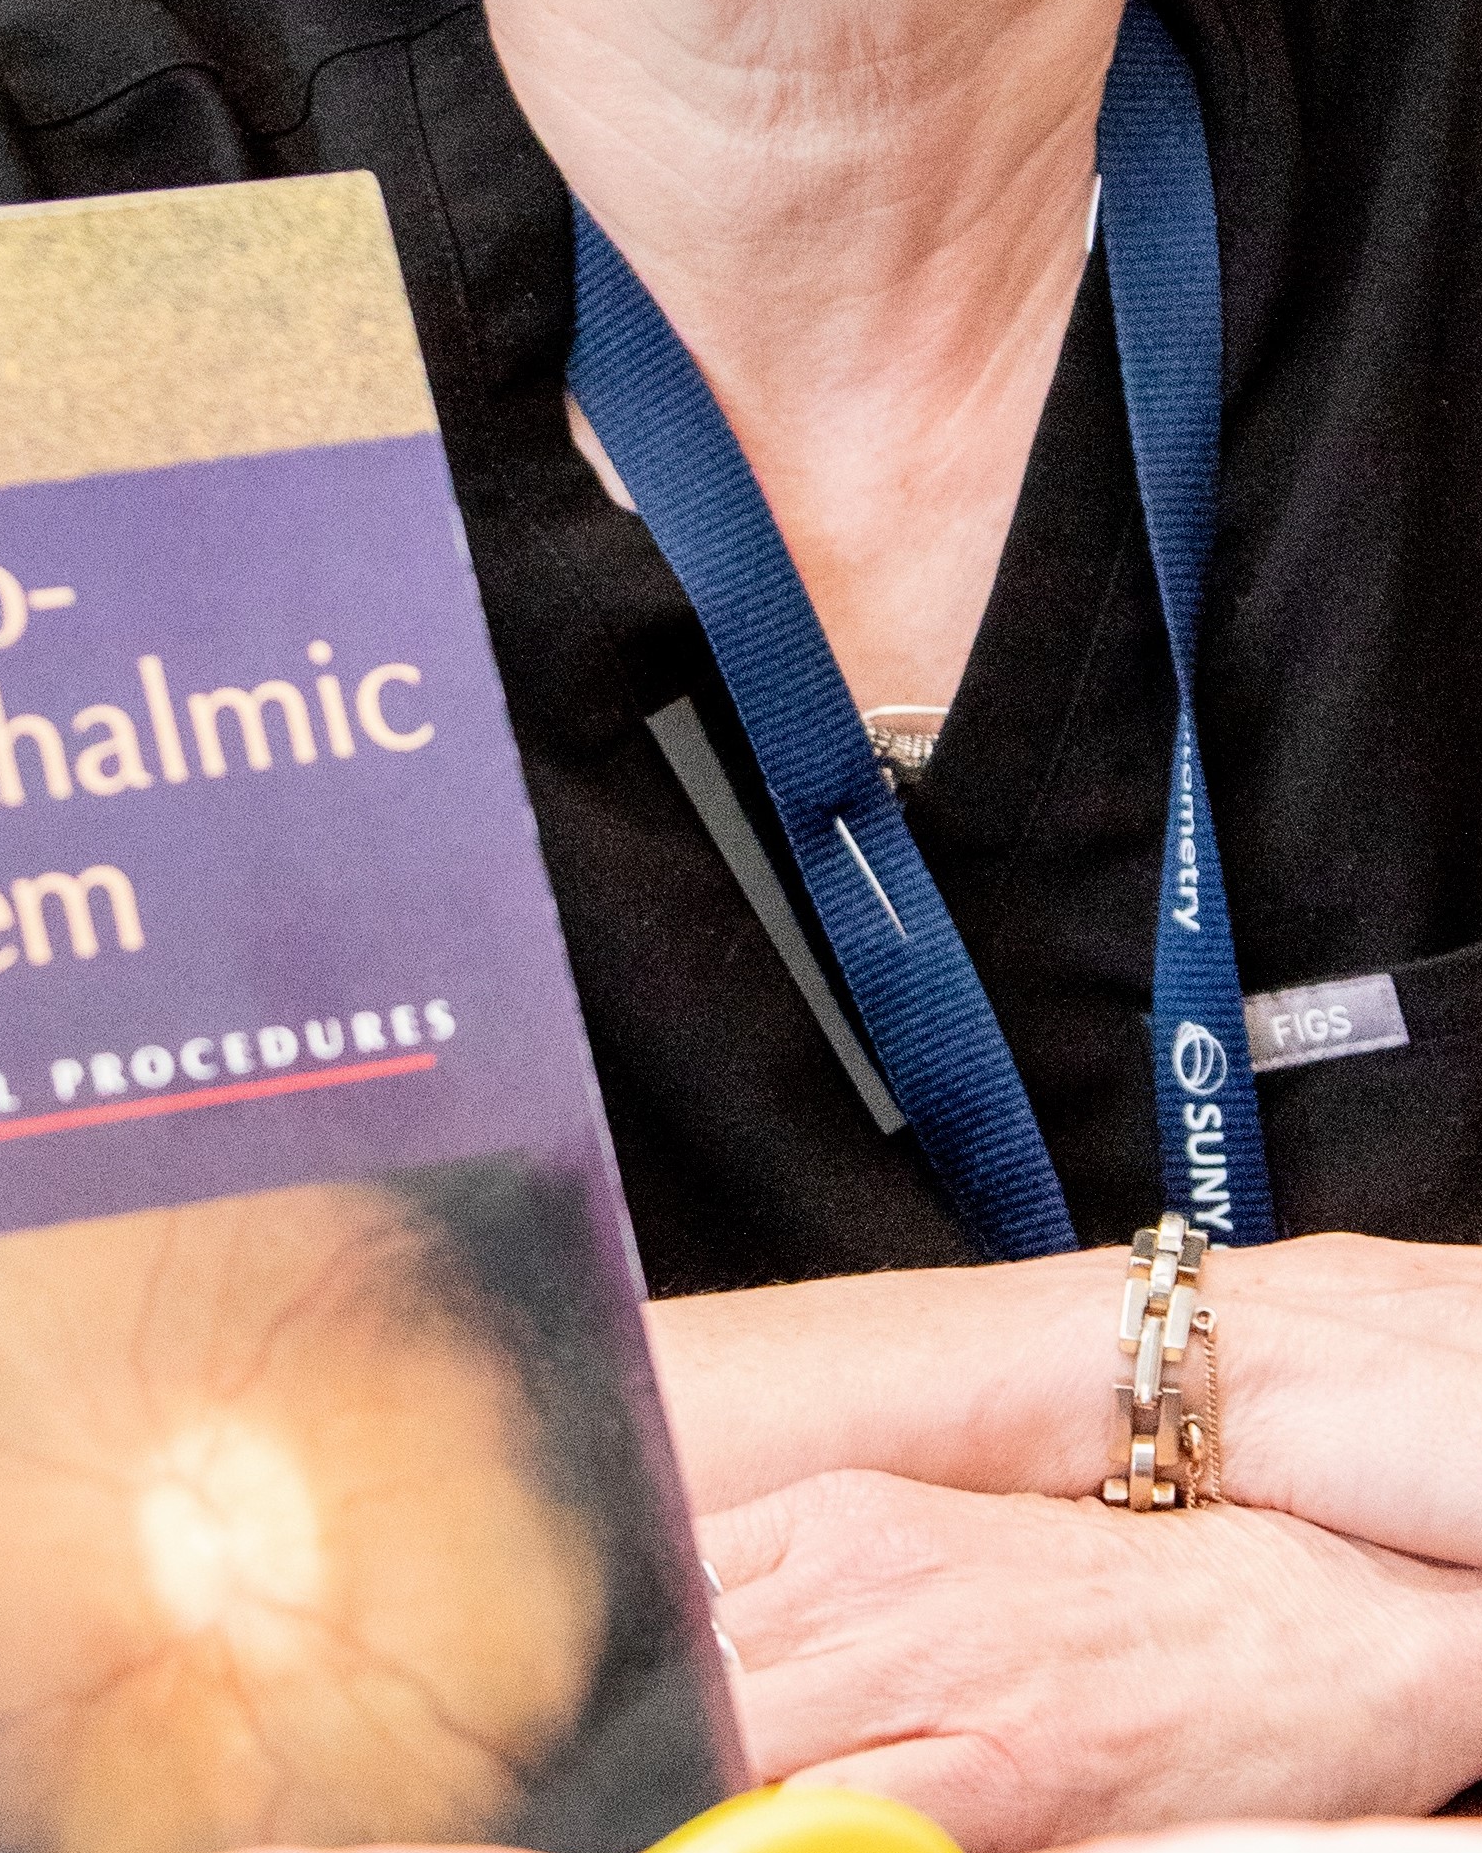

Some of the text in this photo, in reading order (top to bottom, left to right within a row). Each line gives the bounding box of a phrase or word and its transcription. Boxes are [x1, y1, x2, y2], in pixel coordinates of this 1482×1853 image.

[1171, 712, 1201, 930] tometry
[58, 999, 456, 1101] PROCEDURES
[1273, 1008, 1353, 1047] FIGS
[1184, 1103, 1234, 1234] SUNY
